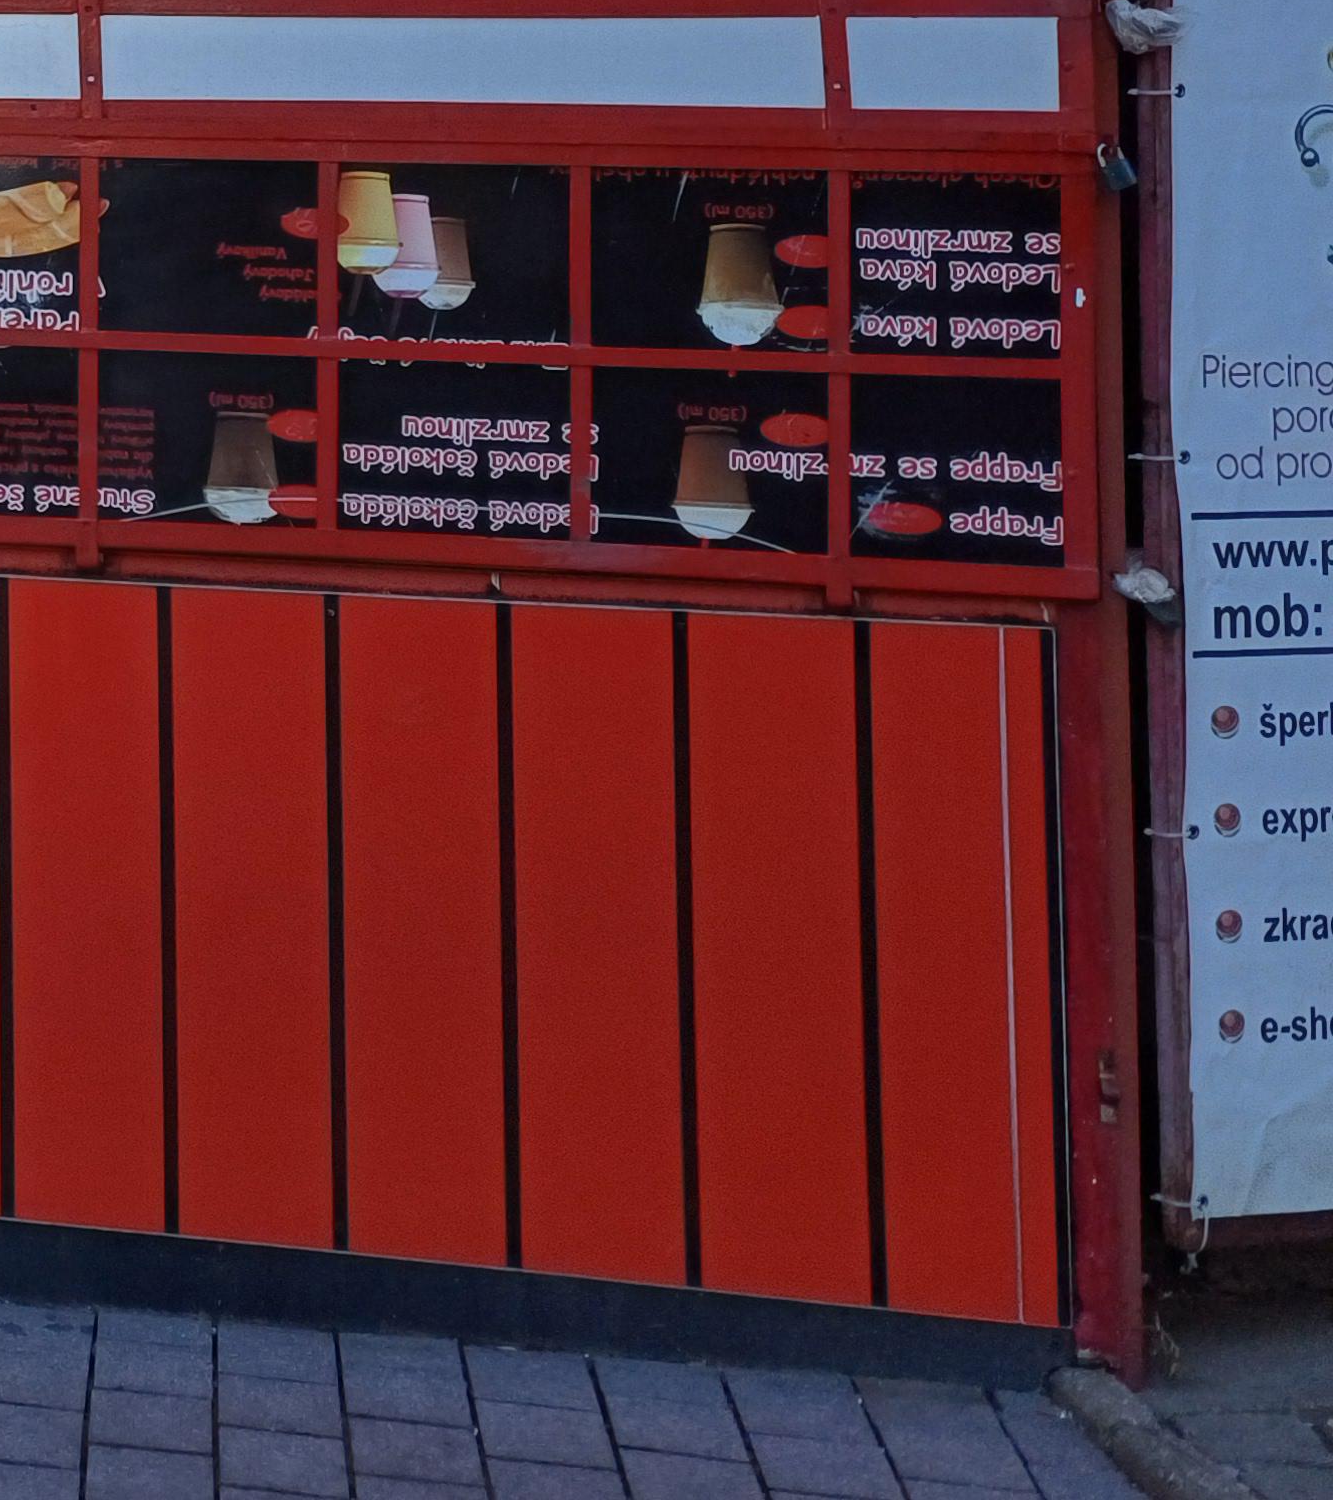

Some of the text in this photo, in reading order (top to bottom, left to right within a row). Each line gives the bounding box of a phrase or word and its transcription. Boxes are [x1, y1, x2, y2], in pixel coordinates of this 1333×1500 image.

[855, 228, 1061, 259] se zmrzlinou
[859, 258, 1062, 293] Ledová káva
[859, 313, 1062, 351] Ledová káva
[1201, 353, 1333, 396] Piercing
[401, 414, 550, 444] zmrzlinou
[1272, 406, 1333, 441] por
[343, 443, 478, 478] čokoláda
[898, 455, 937, 480] se
[949, 450, 1064, 492] Frappe
[1216, 446, 1264, 480] od
[32, 484, 156, 515] Stuené
[343, 492, 478, 531] čokoláda
[949, 505, 1065, 546] Frappe
[1213, 592, 1323, 640] mob:
[1259, 702, 1333, 747] šper
[1261, 806, 1333, 843] expr
[1263, 907, 1333, 943] zkra
